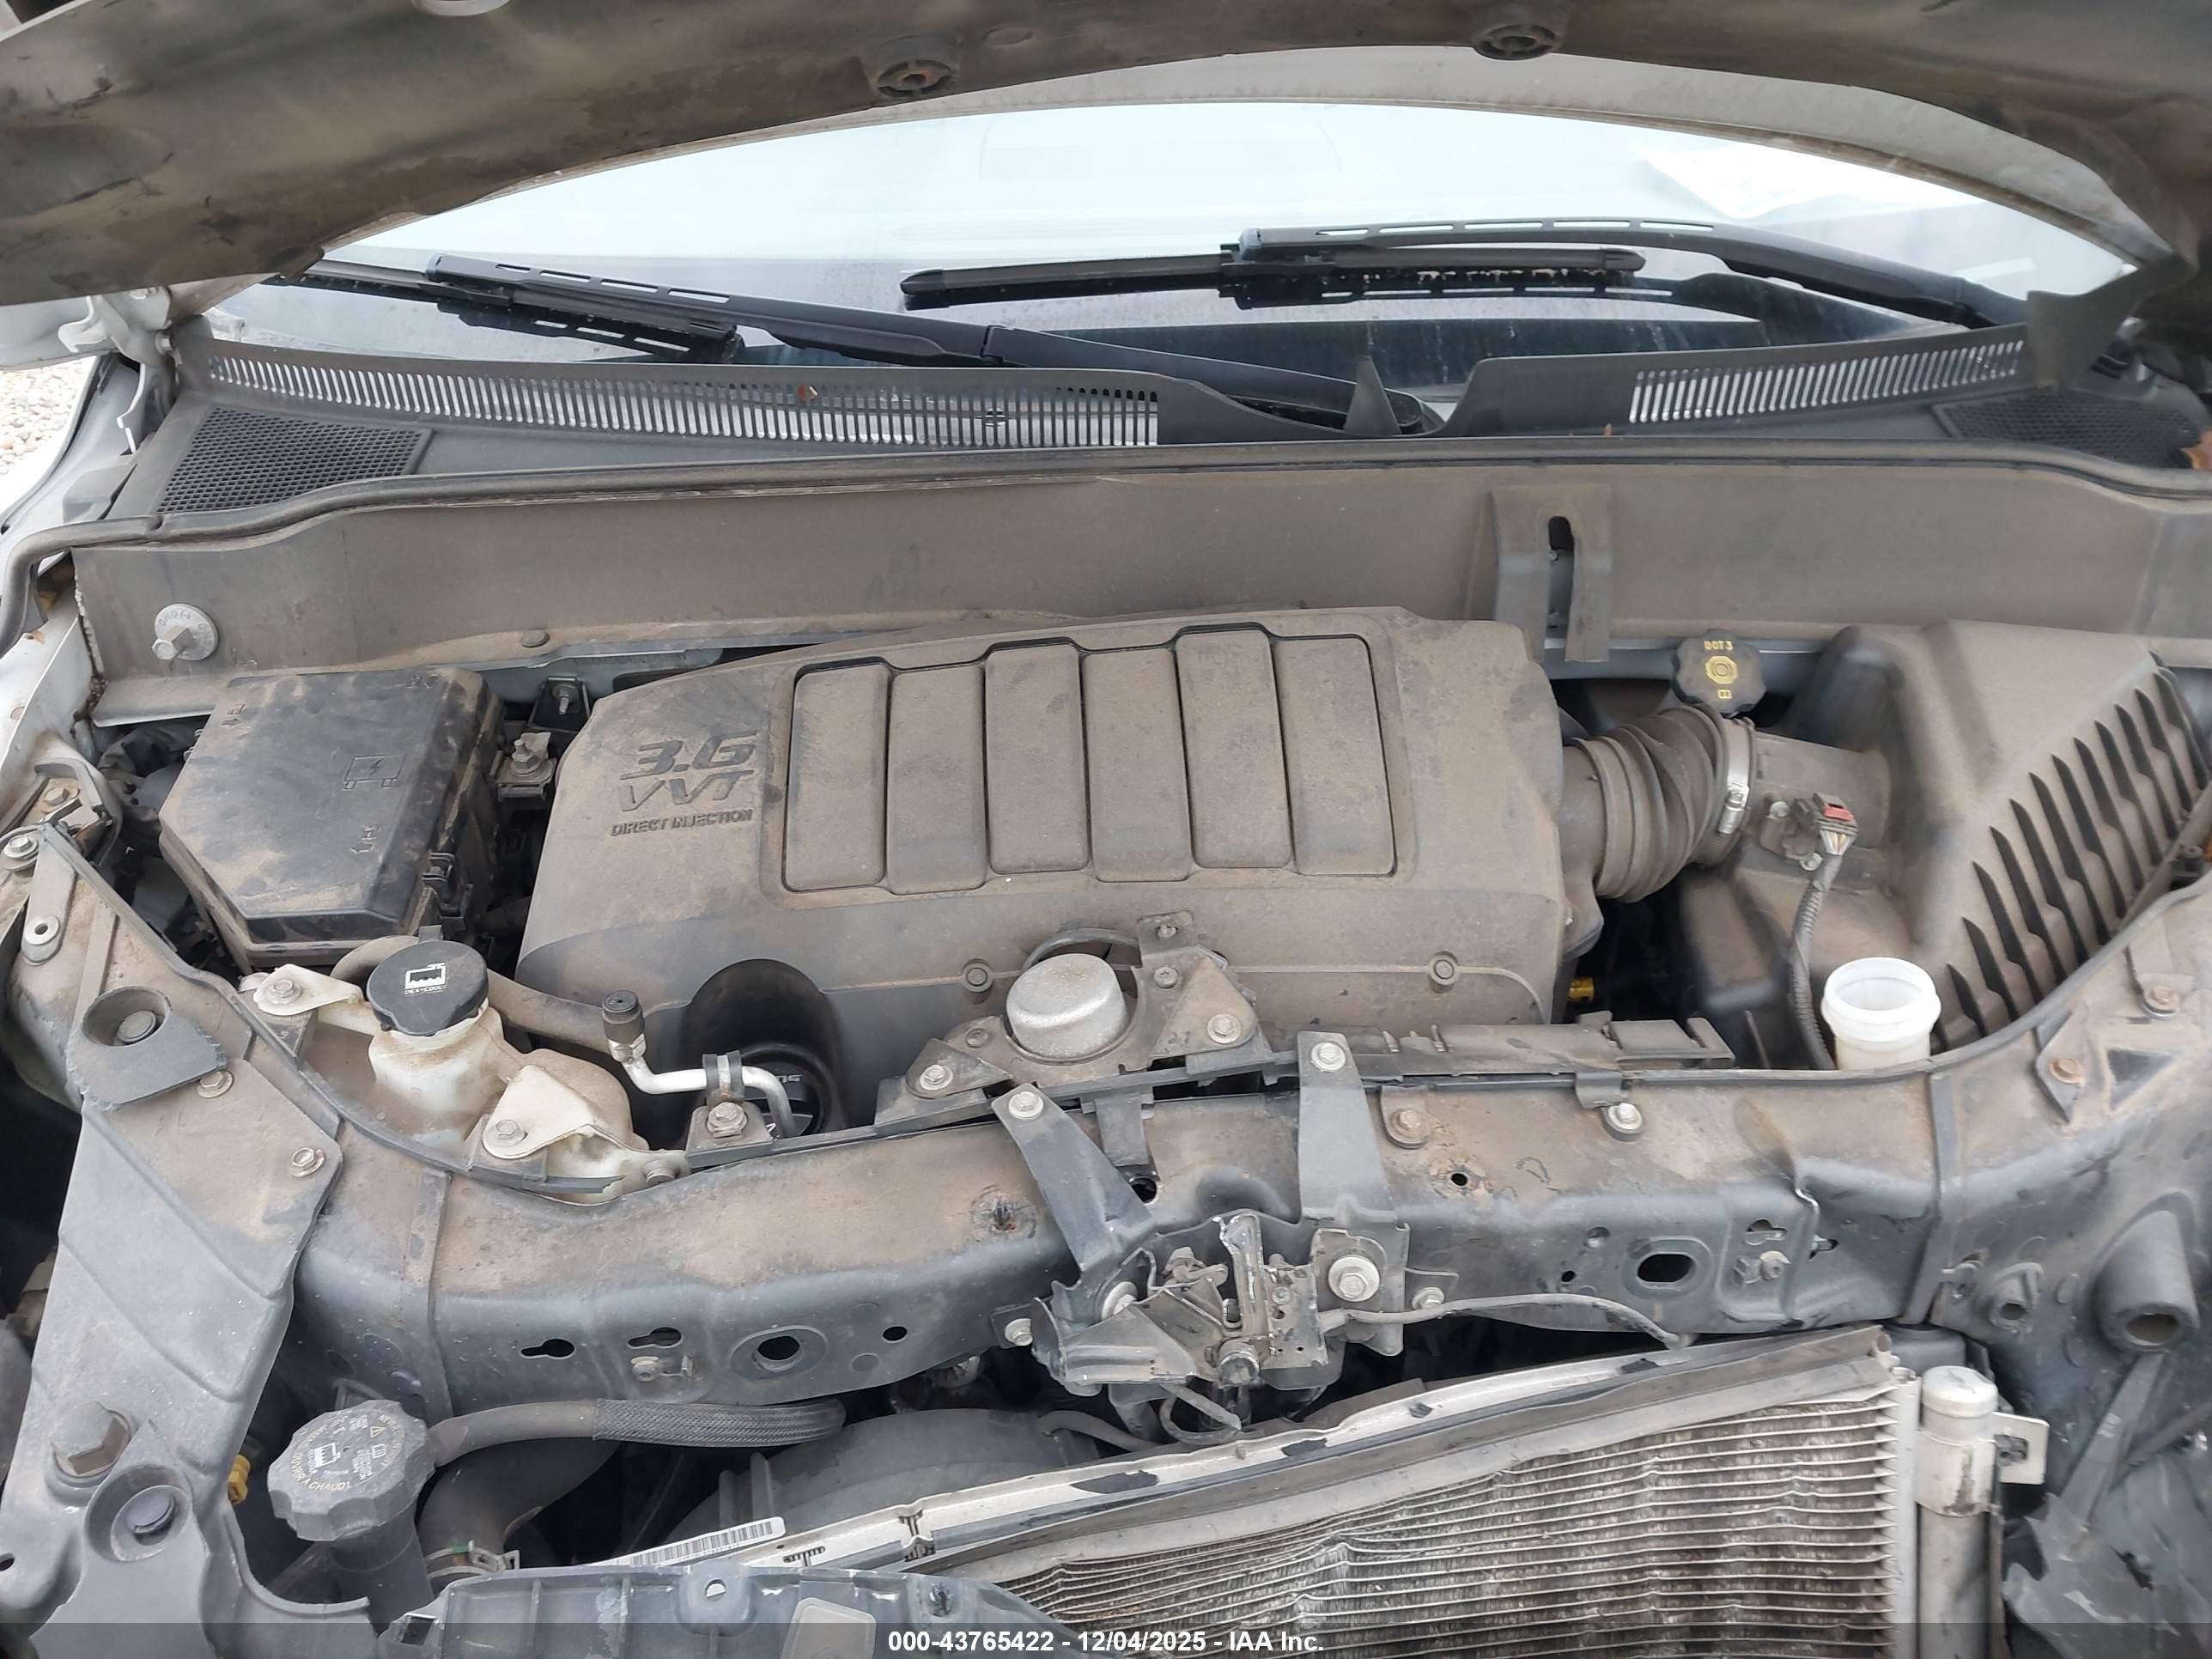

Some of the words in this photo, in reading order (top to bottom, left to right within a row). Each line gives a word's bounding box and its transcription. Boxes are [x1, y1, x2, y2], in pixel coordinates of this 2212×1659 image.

[1725, 641, 1733, 650] 3
[638, 732, 760, 772] 3.6
[618, 769, 755, 811] VVT
[611, 817, 669, 836] DIRECT
[672, 809, 753, 828] INJECTION
